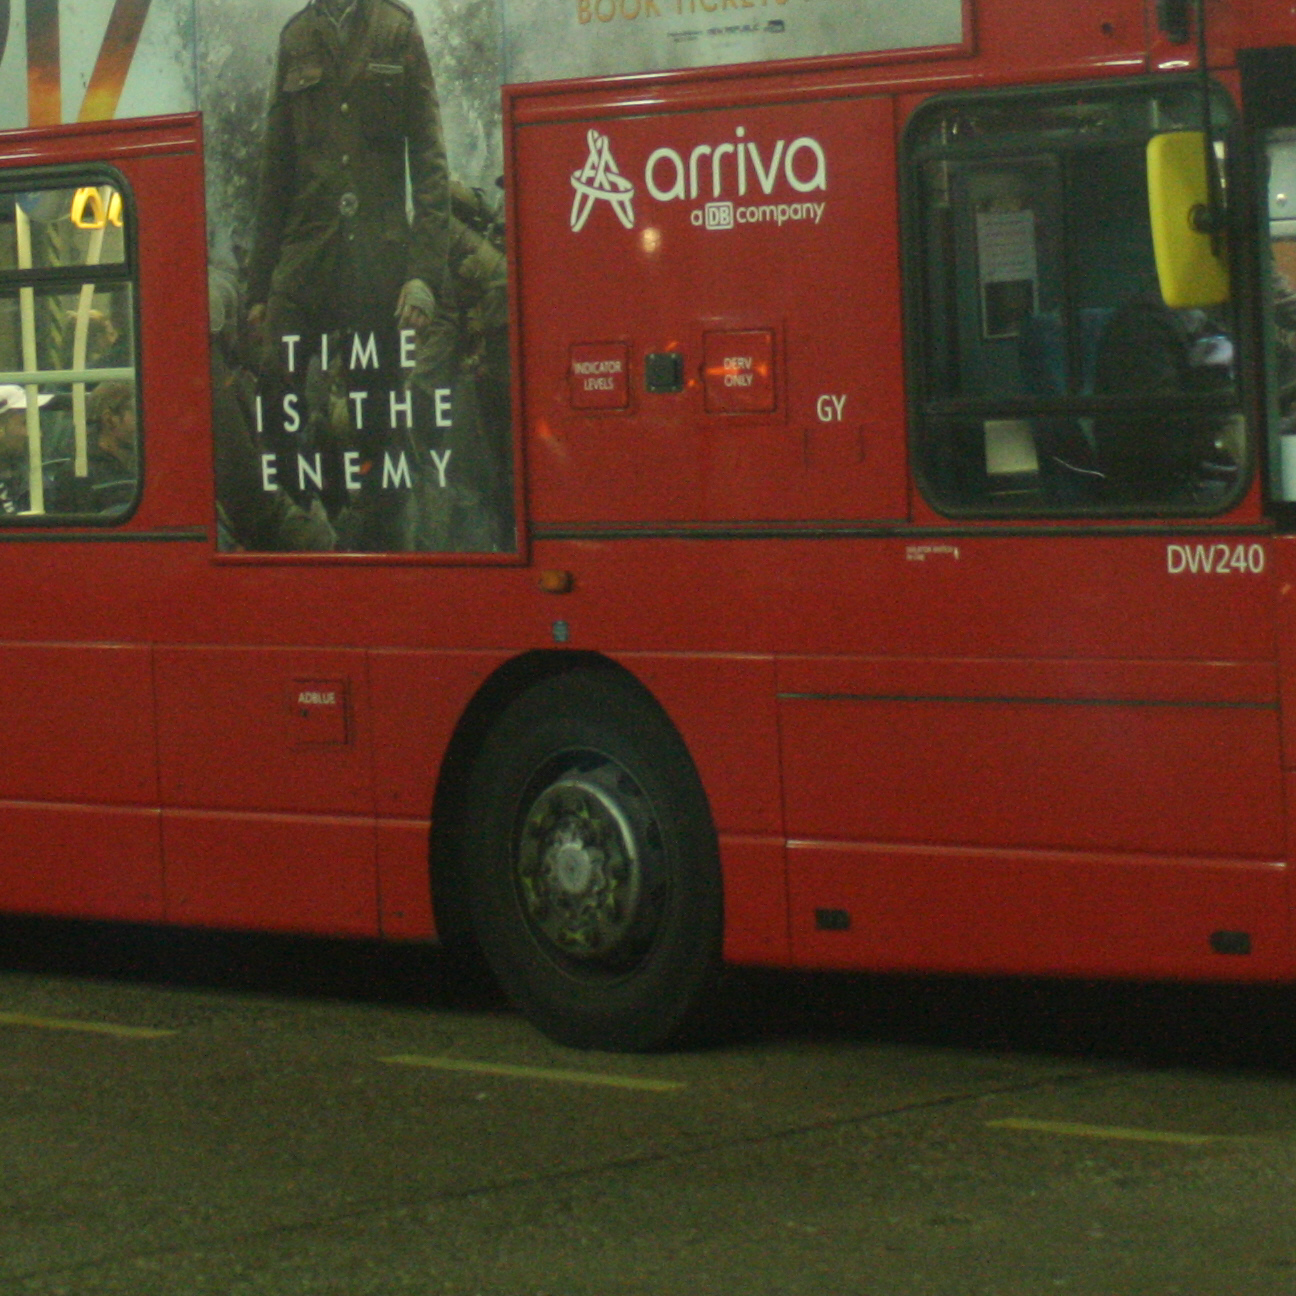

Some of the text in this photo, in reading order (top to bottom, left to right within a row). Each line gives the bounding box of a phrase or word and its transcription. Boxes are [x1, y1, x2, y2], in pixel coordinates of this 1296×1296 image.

[644, 125, 828, 202] arriva
[690, 201, 826, 227] a DB company
[281, 329, 417, 373] TIME
[723, 357, 752, 371] DERV
[573, 360, 623, 375] INDICATOR
[723, 374, 754, 387] ONLY
[584, 377, 615, 391] LEVELS
[255, 388, 453, 433] IS THE
[816, 394, 847, 422] GY
[261, 449, 452, 492] ENEMY
[1166, 543, 1265, 575] DW240
[297, 691, 336, 705] ADBLUE
